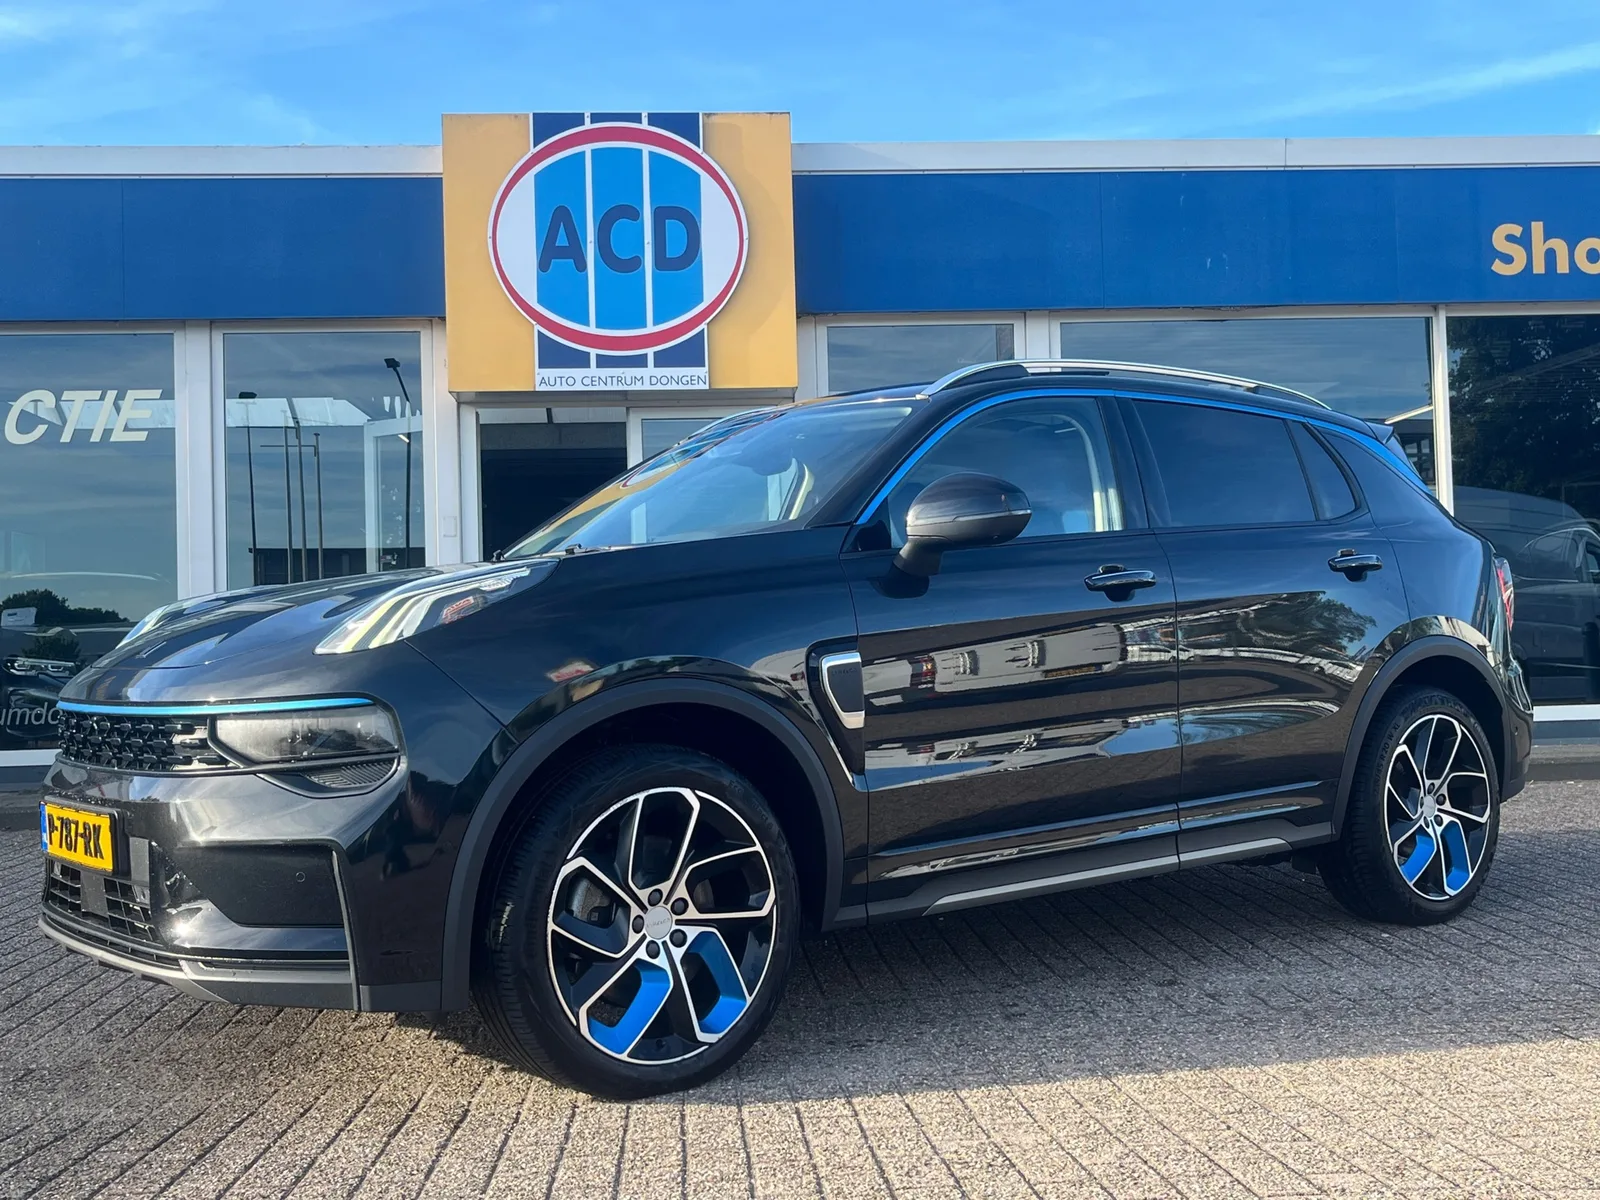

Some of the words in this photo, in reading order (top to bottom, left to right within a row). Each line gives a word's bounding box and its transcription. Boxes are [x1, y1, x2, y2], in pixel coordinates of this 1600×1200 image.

[538, 204, 701, 273] ACD
[1491, 221, 1600, 276] Sho
[538, 376, 576, 387] AUTO
[581, 375, 644, 387] CENTRUM
[649, 374, 707, 386] DONGEN
[4, 389, 163, 445] CTIE
[47, 812, 104, 860] P-787-RK
